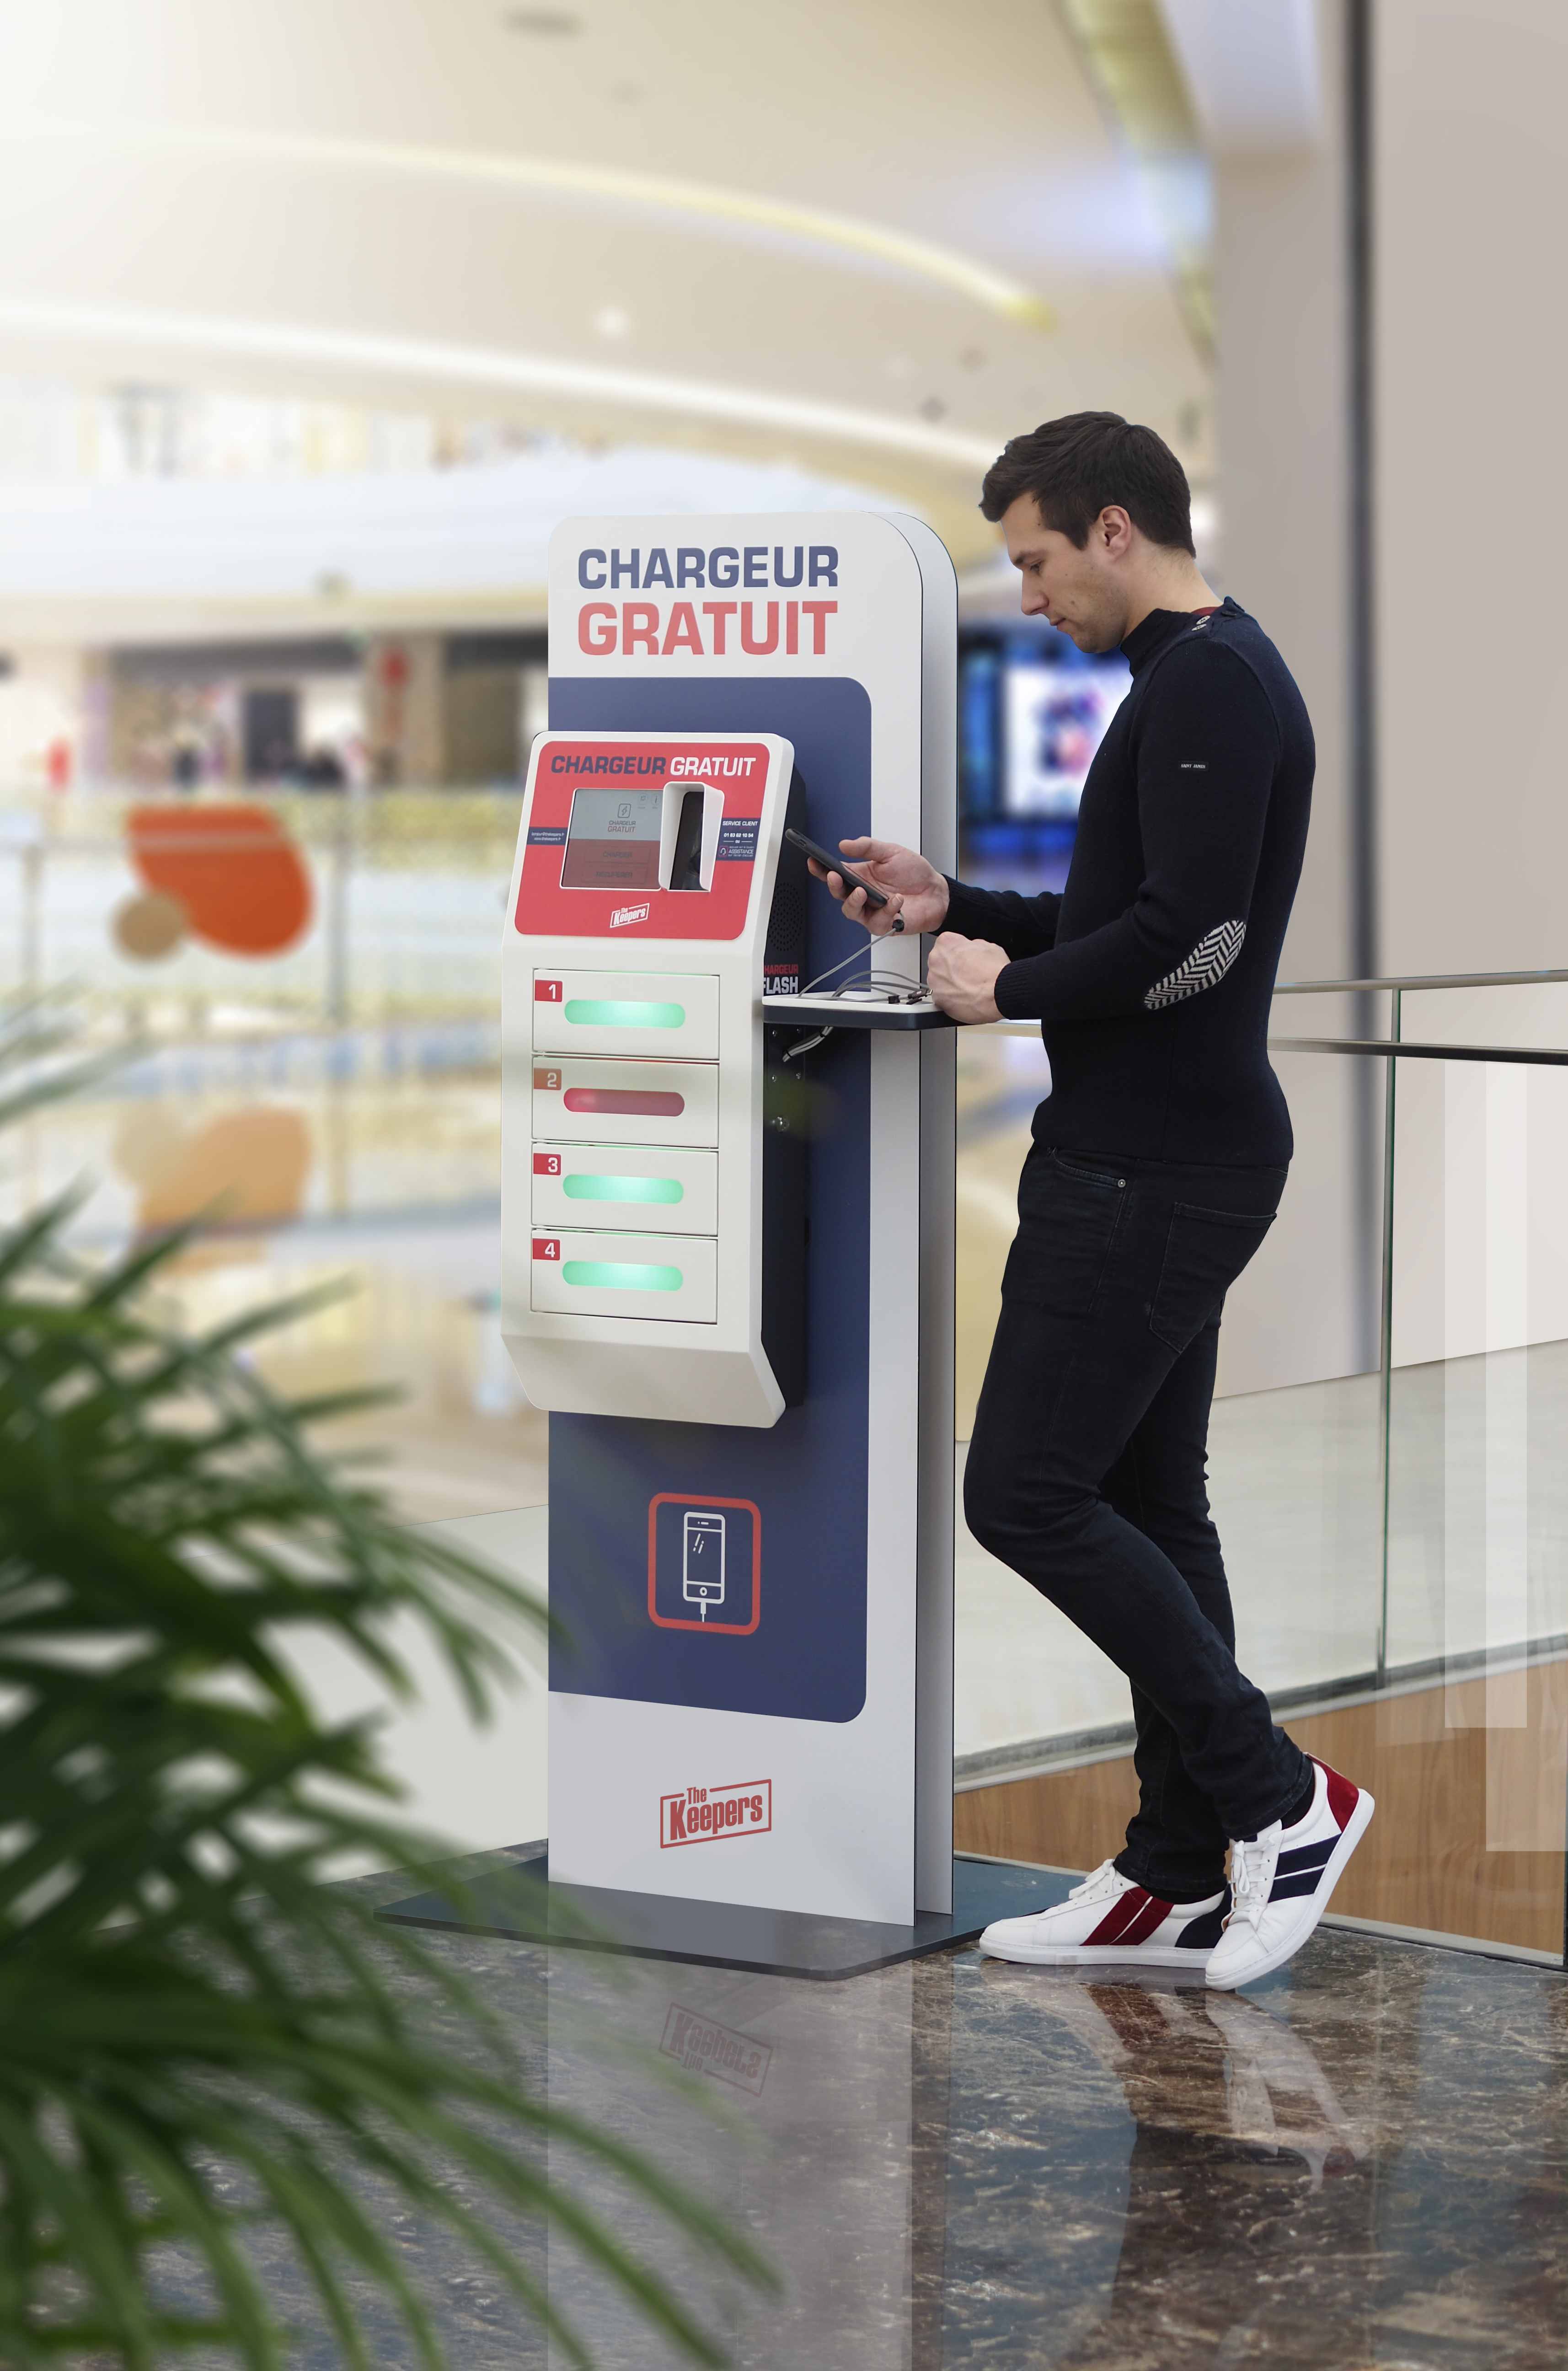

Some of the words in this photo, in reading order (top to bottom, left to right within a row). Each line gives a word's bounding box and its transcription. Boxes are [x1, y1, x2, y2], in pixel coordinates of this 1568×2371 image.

[578, 546, 838, 589] CHARGEUR
[578, 601, 838, 655] GRATUIT
[551, 756, 666, 774] CHARGEUR
[670, 757, 756, 776] GRATUIT
[614, 908, 646, 925] Keepers
[764, 964, 798, 975] HARGEUR
[548, 984, 556, 999] 1
[547, 1073, 557, 1087] 2
[548, 1157, 558, 1173] 3
[545, 1243, 556, 1257] 4
[687, 1786, 706, 1805] The
[670, 1795, 763, 1841] Keepers
